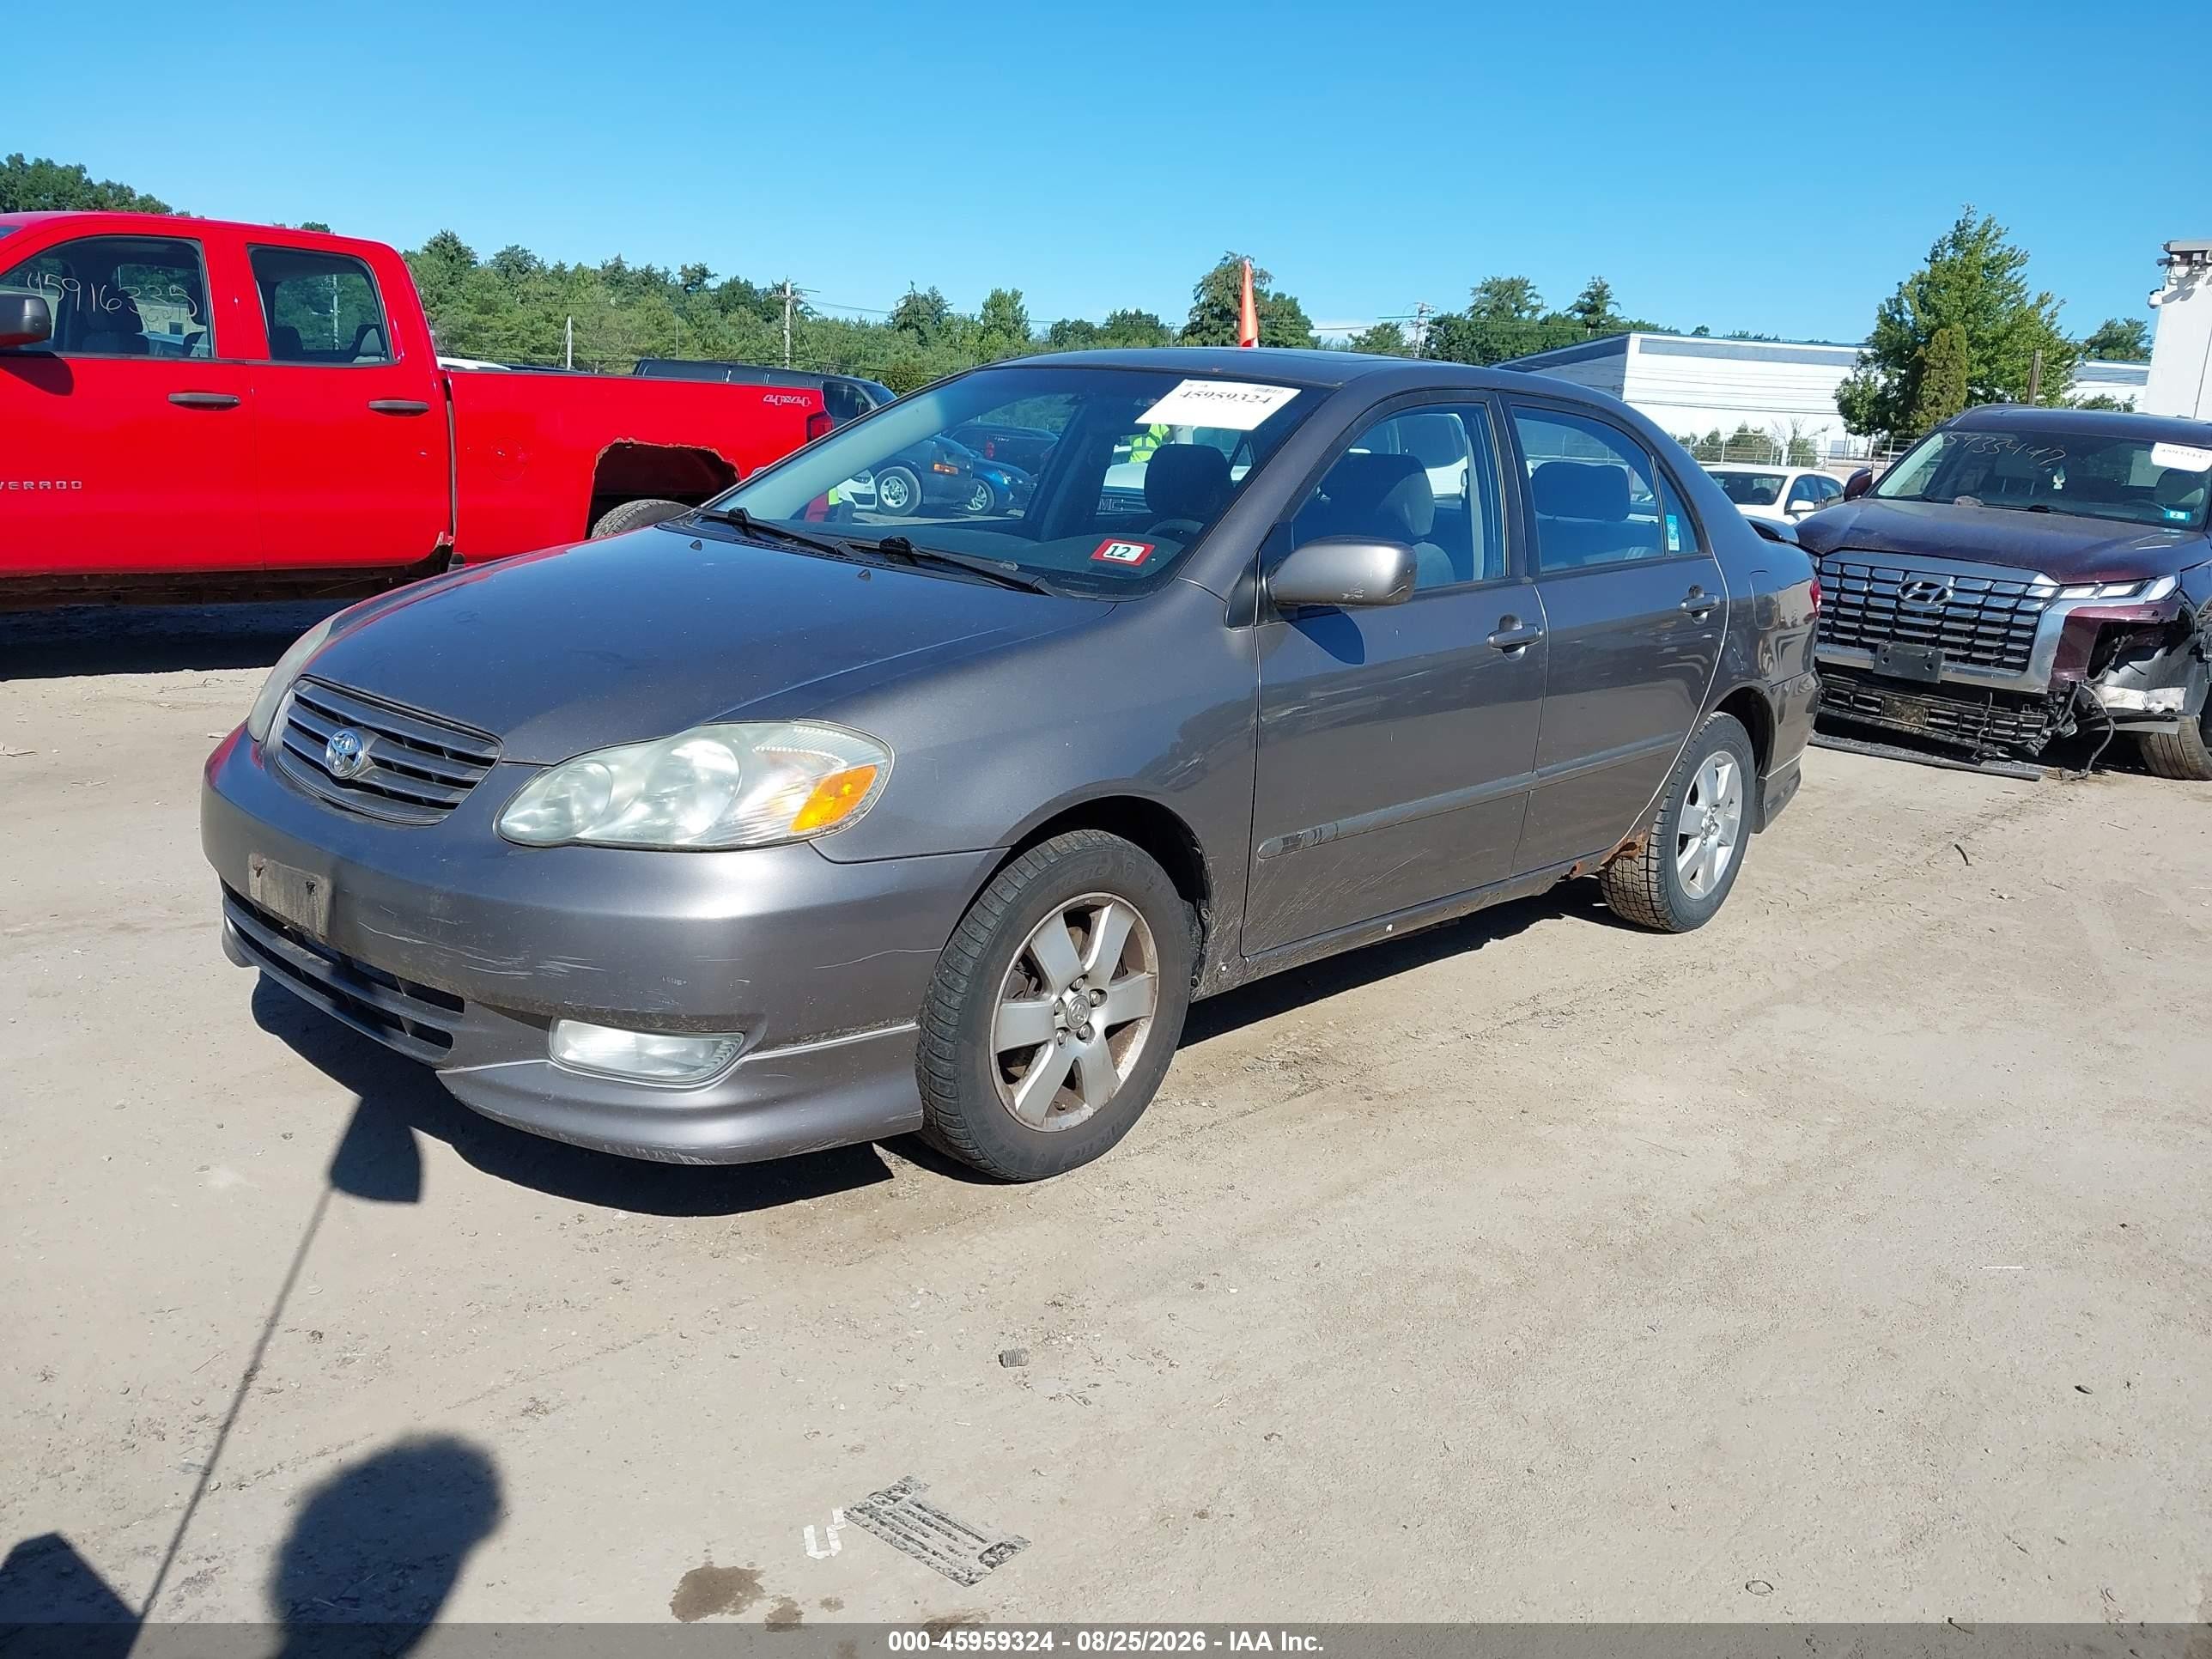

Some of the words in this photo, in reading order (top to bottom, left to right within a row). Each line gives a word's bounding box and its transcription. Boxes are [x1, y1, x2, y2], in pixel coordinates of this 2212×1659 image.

[1179, 391, 1273, 404] 45959324
[1943, 431, 2066, 465] 5933447
[1105, 545, 1132, 558] 12
